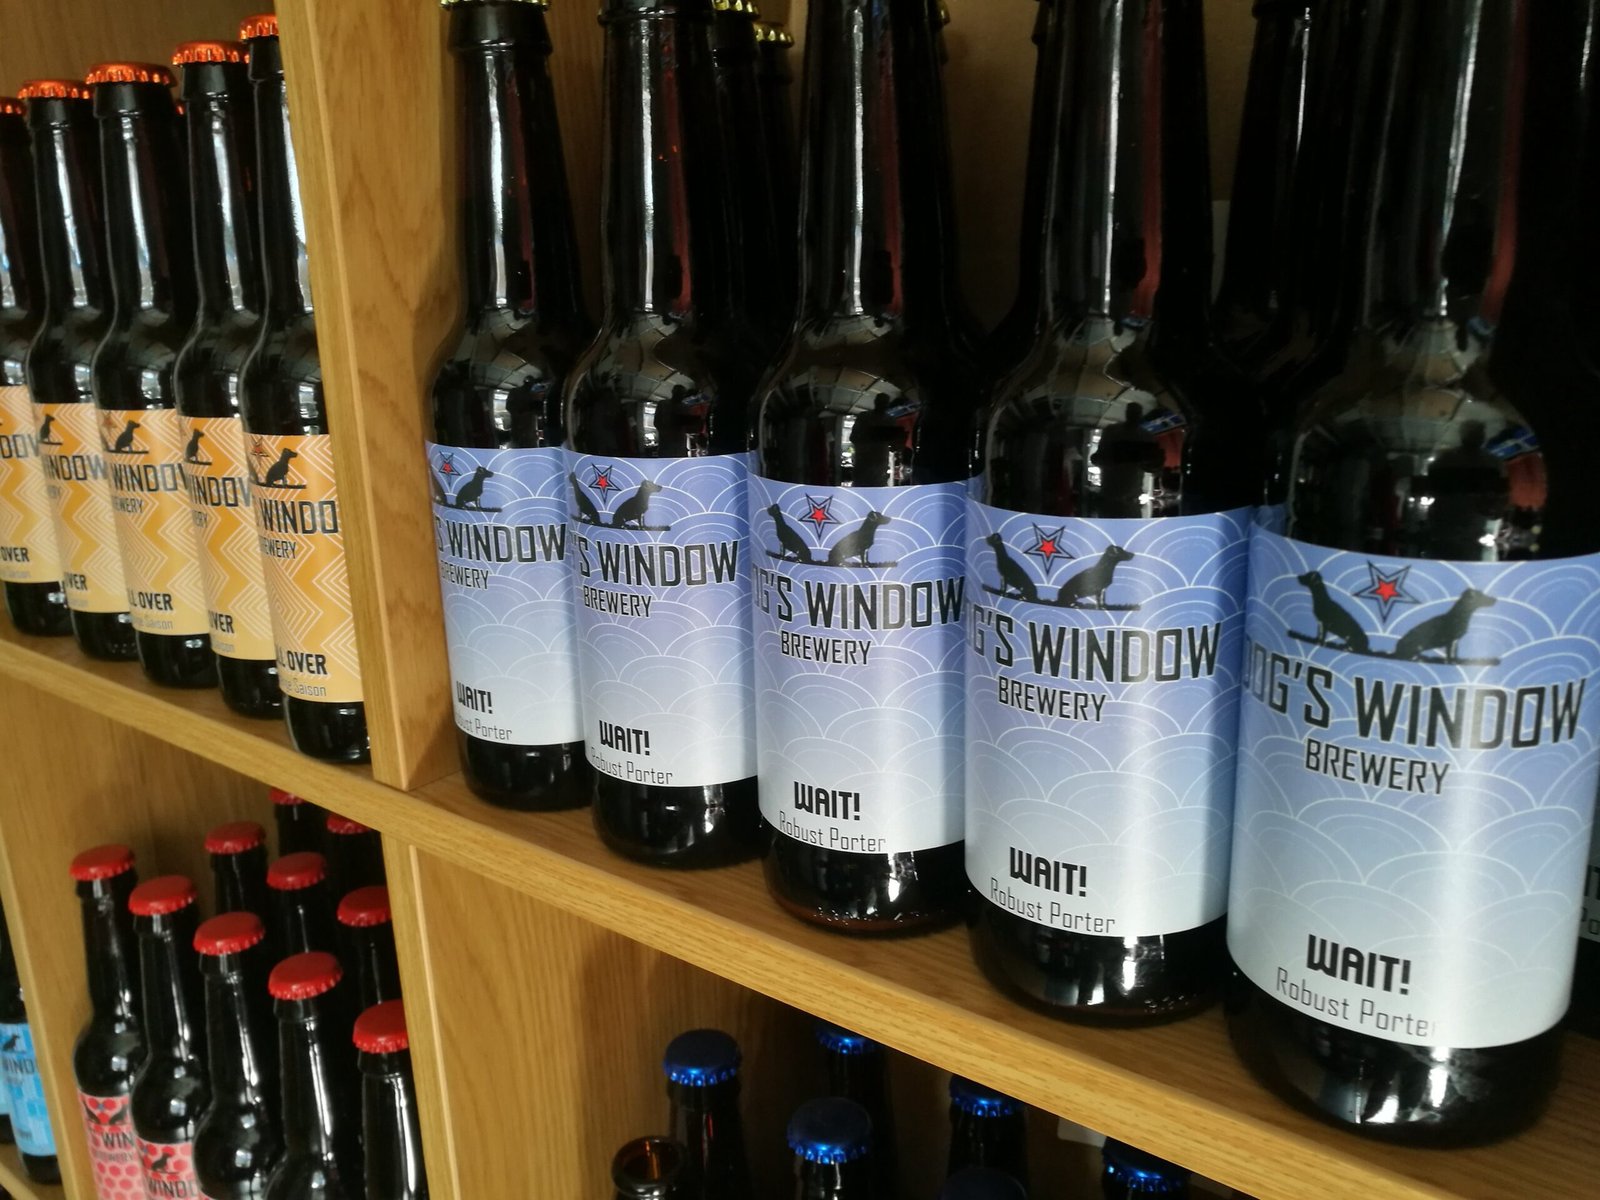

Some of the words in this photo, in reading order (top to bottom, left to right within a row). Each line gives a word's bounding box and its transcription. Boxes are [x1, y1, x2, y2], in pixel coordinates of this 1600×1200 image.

[446, 520, 567, 564] WINDOW
[597, 540, 739, 587] WINDOW
[138, 592, 174, 612] OVER
[584, 585, 652, 618] BREWERY
[805, 576, 965, 630] WINDOW
[287, 650, 328, 676] OVER
[781, 630, 871, 665] BREWERY
[1029, 622, 1222, 684] WINDOW
[456, 681, 493, 714] WAIT!
[999, 675, 1106, 722] BREWERY
[1355, 676, 1586, 752] WINDOW
[475, 717, 513, 741] Porter
[599, 720, 651, 756] WAIT!
[626, 760, 673, 785] Porter
[1304, 738, 1450, 795] BREWERY
[793, 780, 861, 821] WAIT!
[779, 810, 824, 847] Robust
[829, 827, 887, 853] Porter
[1009, 846, 1087, 898] WAIT!
[990, 877, 1042, 922] Robust
[1049, 901, 1116, 935] Porter
[1306, 934, 1411, 996] WAIT!
[1276, 966, 1350, 1021] Robust
